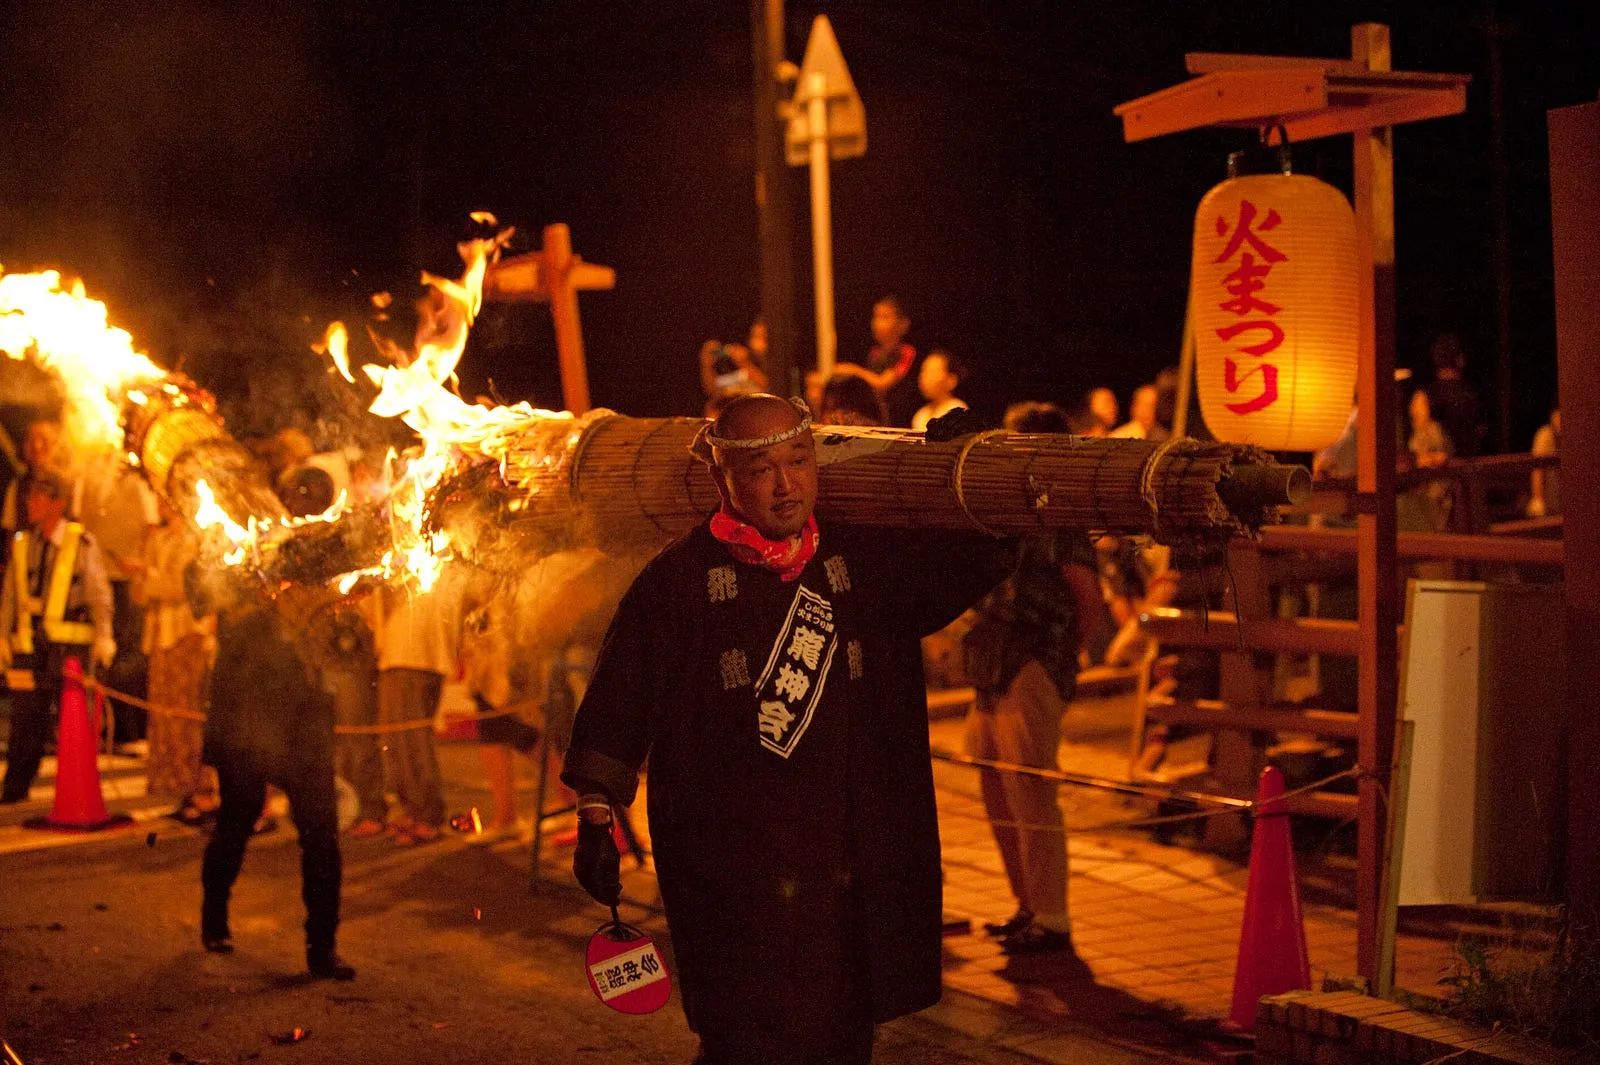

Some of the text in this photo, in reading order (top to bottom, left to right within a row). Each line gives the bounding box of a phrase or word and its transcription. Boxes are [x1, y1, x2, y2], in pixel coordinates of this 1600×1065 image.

[1212, 199, 1290, 416] 火まつり
[757, 625, 826, 742] 龍神会
[604, 953, 659, 989] 龍神会
